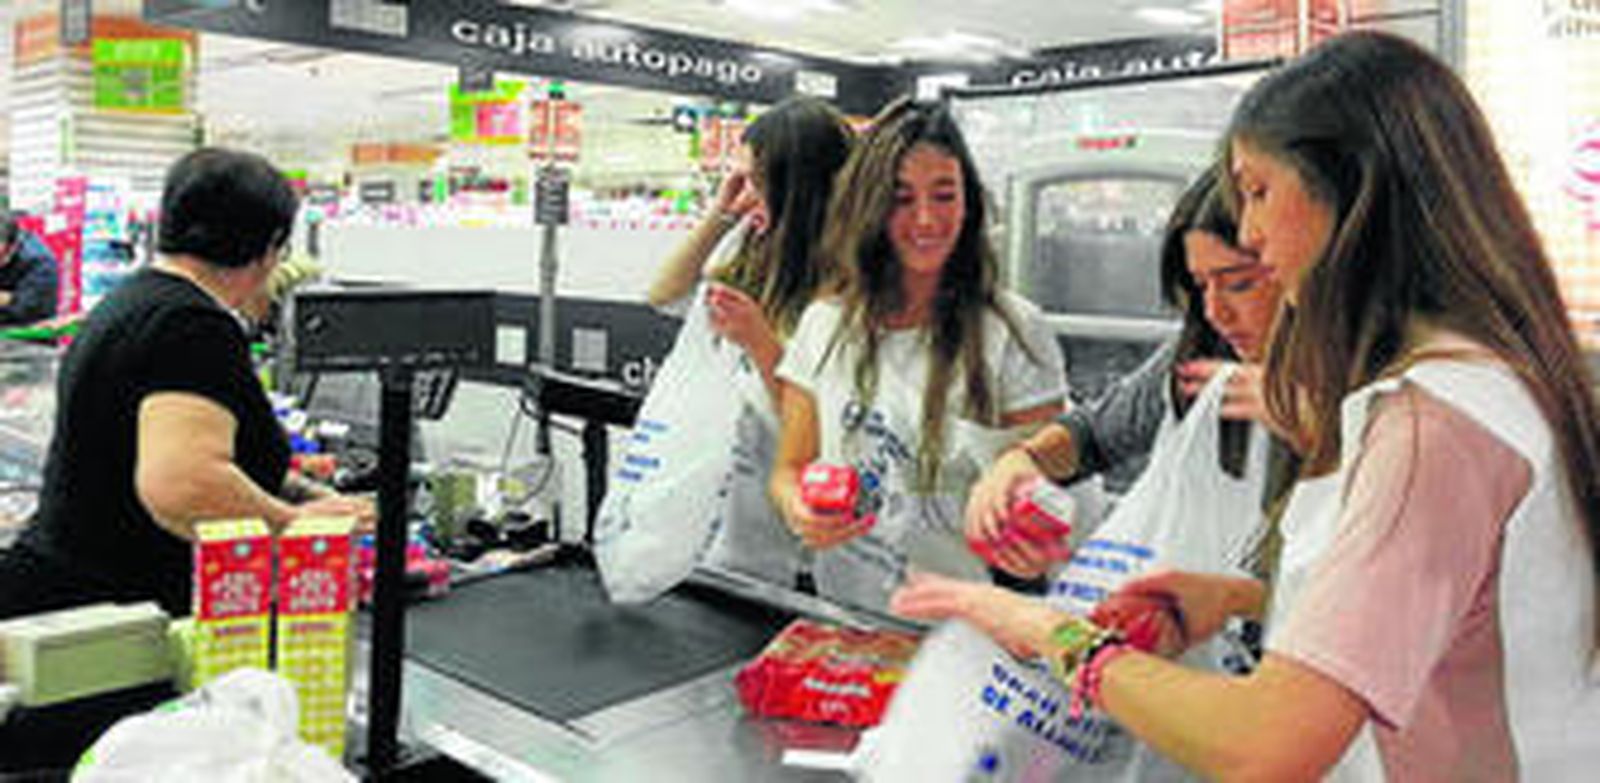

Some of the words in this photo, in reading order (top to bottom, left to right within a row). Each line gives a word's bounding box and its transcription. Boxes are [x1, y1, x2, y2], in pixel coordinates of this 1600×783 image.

[451, 20, 554, 54] caja
[571, 41, 763, 83] autopago
[1121, 51, 1204, 77] aut
